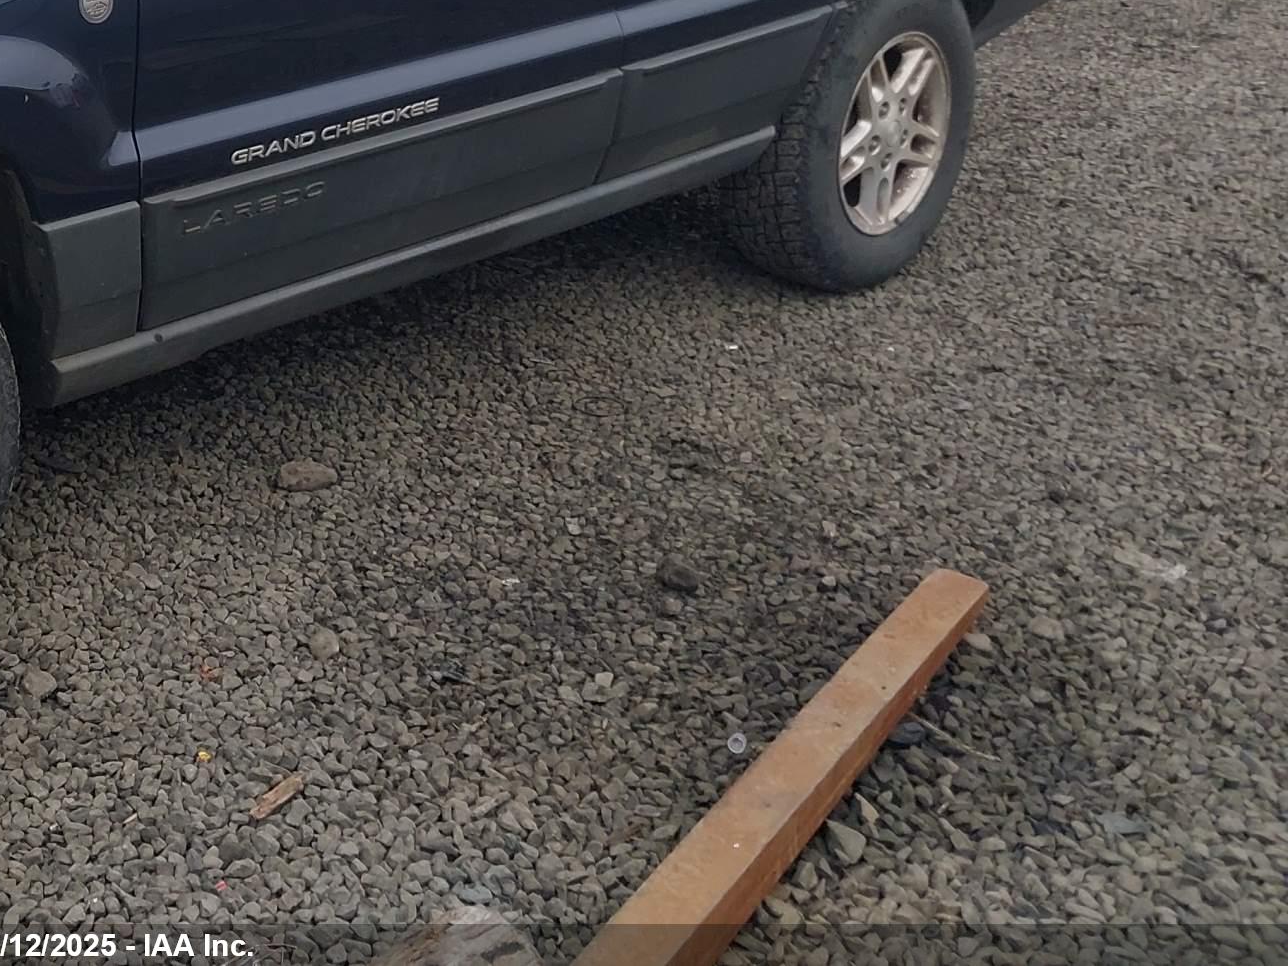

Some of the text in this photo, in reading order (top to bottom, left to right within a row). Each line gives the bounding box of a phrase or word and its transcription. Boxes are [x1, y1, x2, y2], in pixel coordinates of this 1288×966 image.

[230, 97, 441, 166] GRAND CHEROKEE
[182, 180, 326, 235] LAREDO
